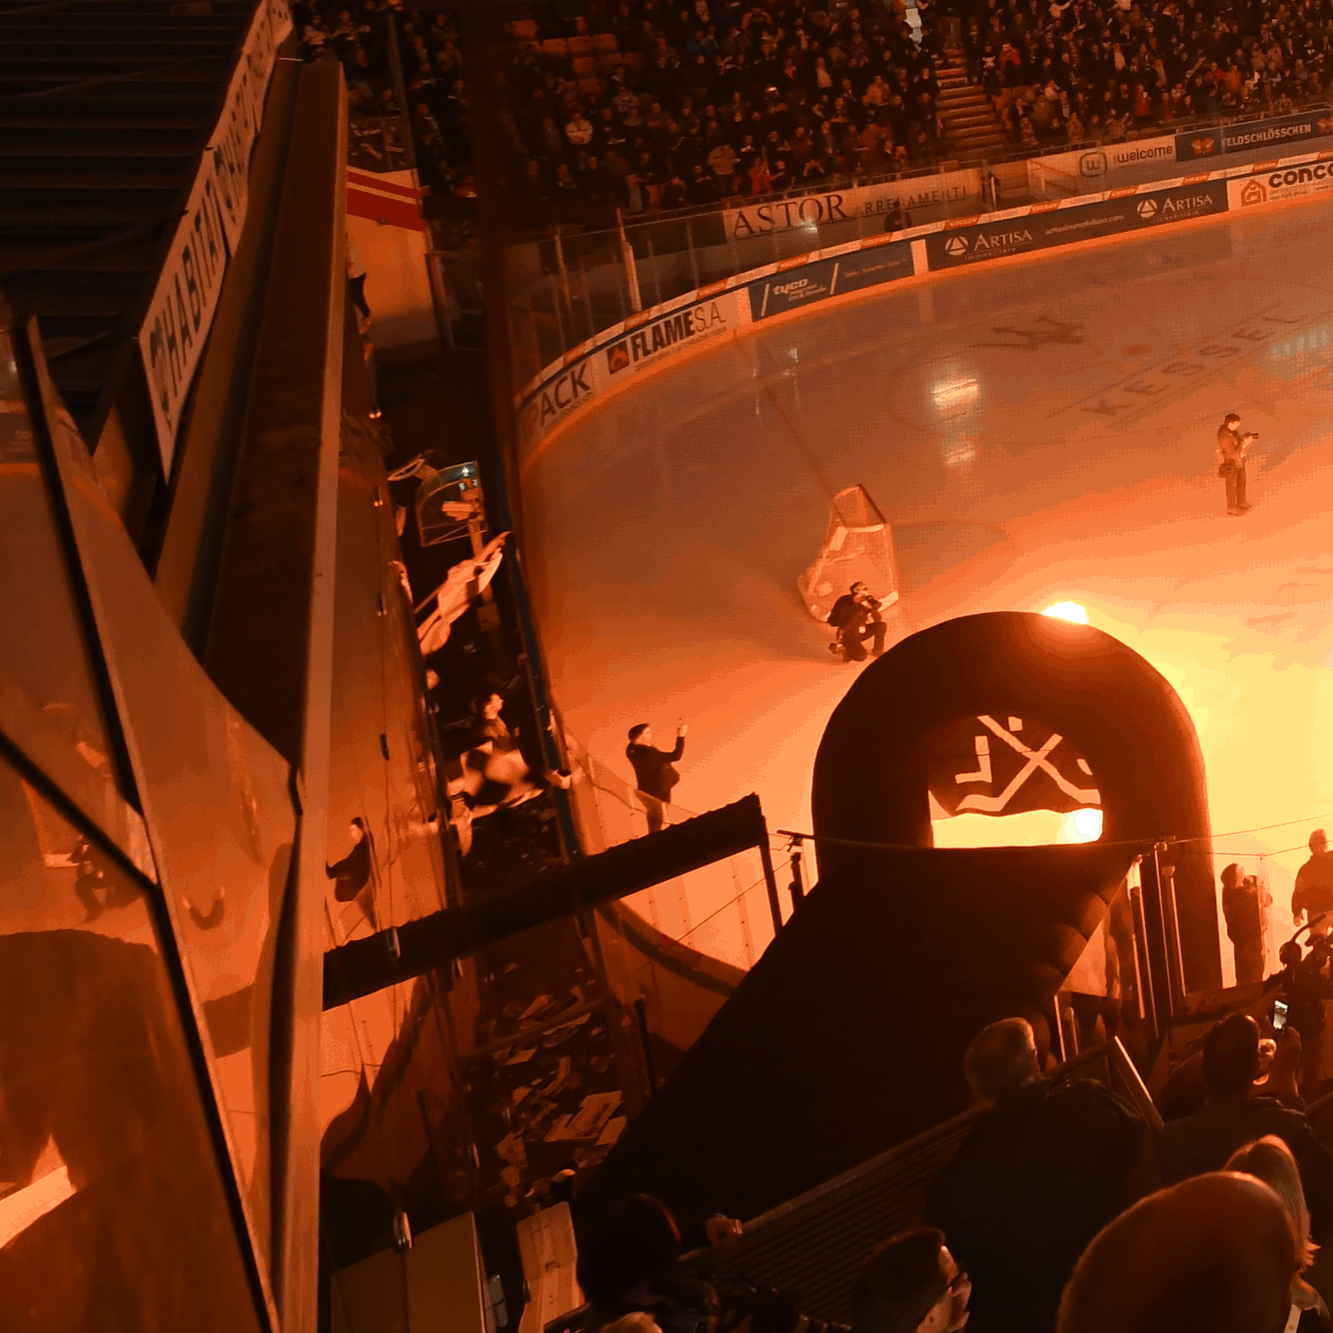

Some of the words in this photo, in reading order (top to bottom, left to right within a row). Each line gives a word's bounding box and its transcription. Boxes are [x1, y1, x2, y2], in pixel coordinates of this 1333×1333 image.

[733, 193, 851, 238] ASTOR
[1161, 193, 1213, 214] ARTISA
[973, 229, 1033, 251] ARTISA
[163, 174, 223, 405] HABITAT
[772, 278, 808, 296] tyco
[630, 310, 696, 363] FLAME
